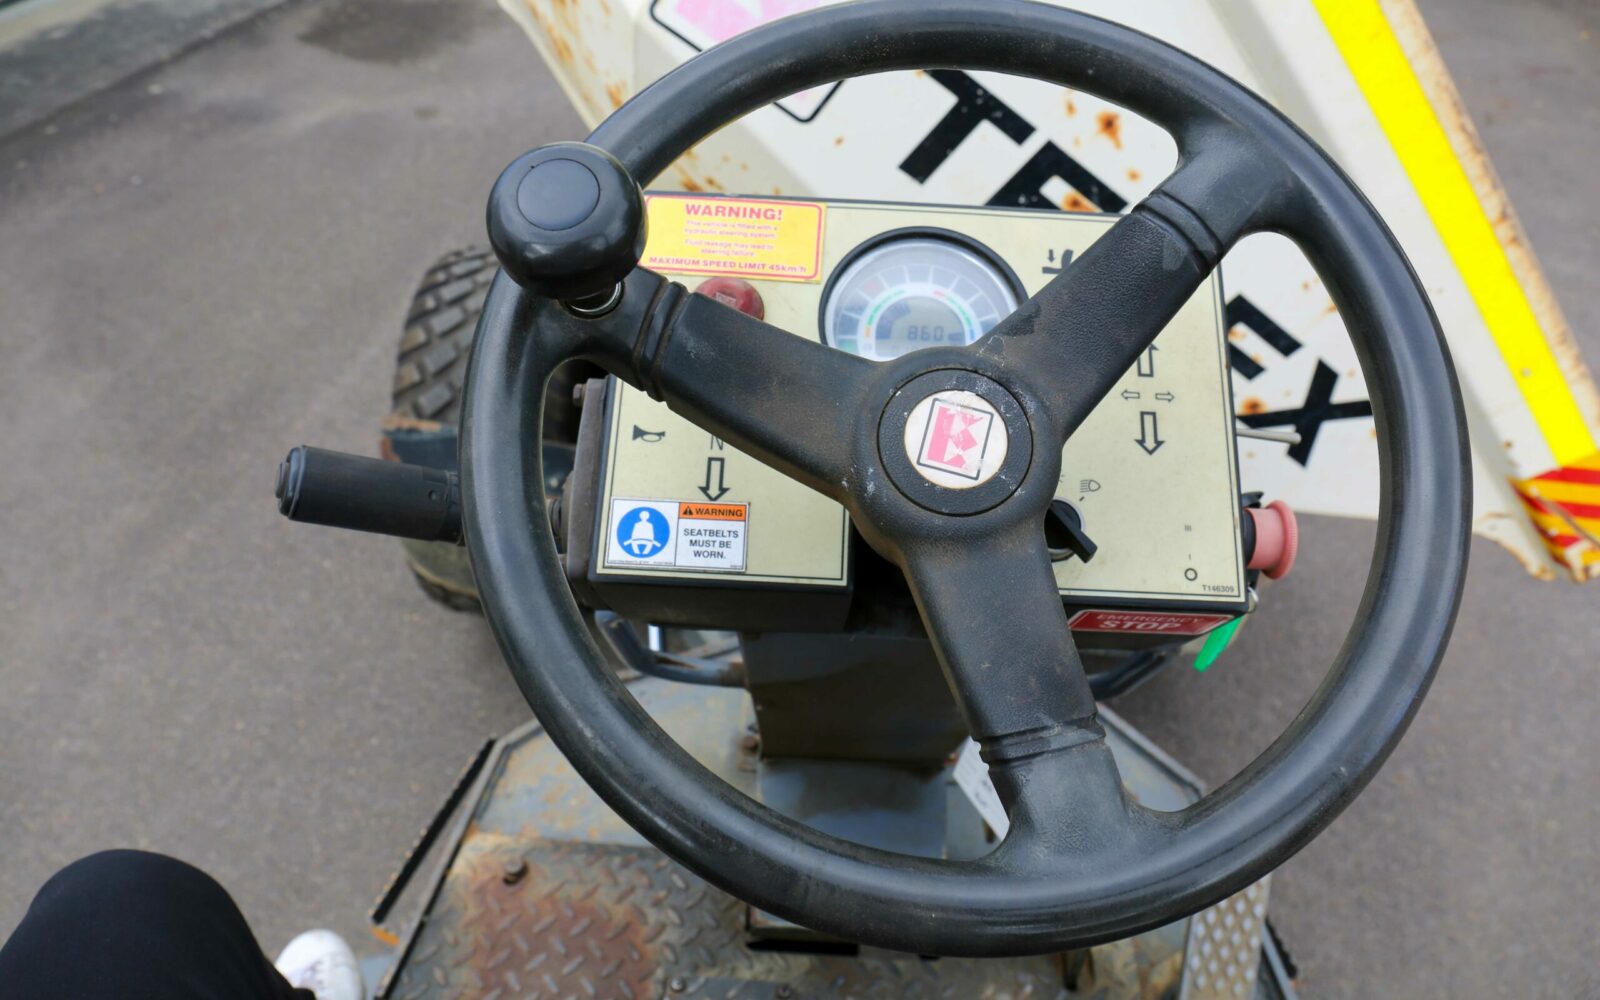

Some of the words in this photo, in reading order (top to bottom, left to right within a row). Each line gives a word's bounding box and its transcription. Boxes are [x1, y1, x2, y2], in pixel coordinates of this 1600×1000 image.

[685, 203, 783, 221] WARNING!
[649, 256, 701, 266] MAXIMUM
[702, 259, 736, 269] SPEED
[738, 261, 767, 271] LIMIT
[907, 325, 945, 341] 860
[695, 508, 743, 518] WARNING
[683, 528, 740, 539] SEATBELTS
[689, 539, 717, 548] MUST
[718, 541, 732, 549] BE
[693, 550, 726, 559] WORN.
[1202, 584, 1235, 593] T146309
[1099, 620, 1182, 631] STOP
